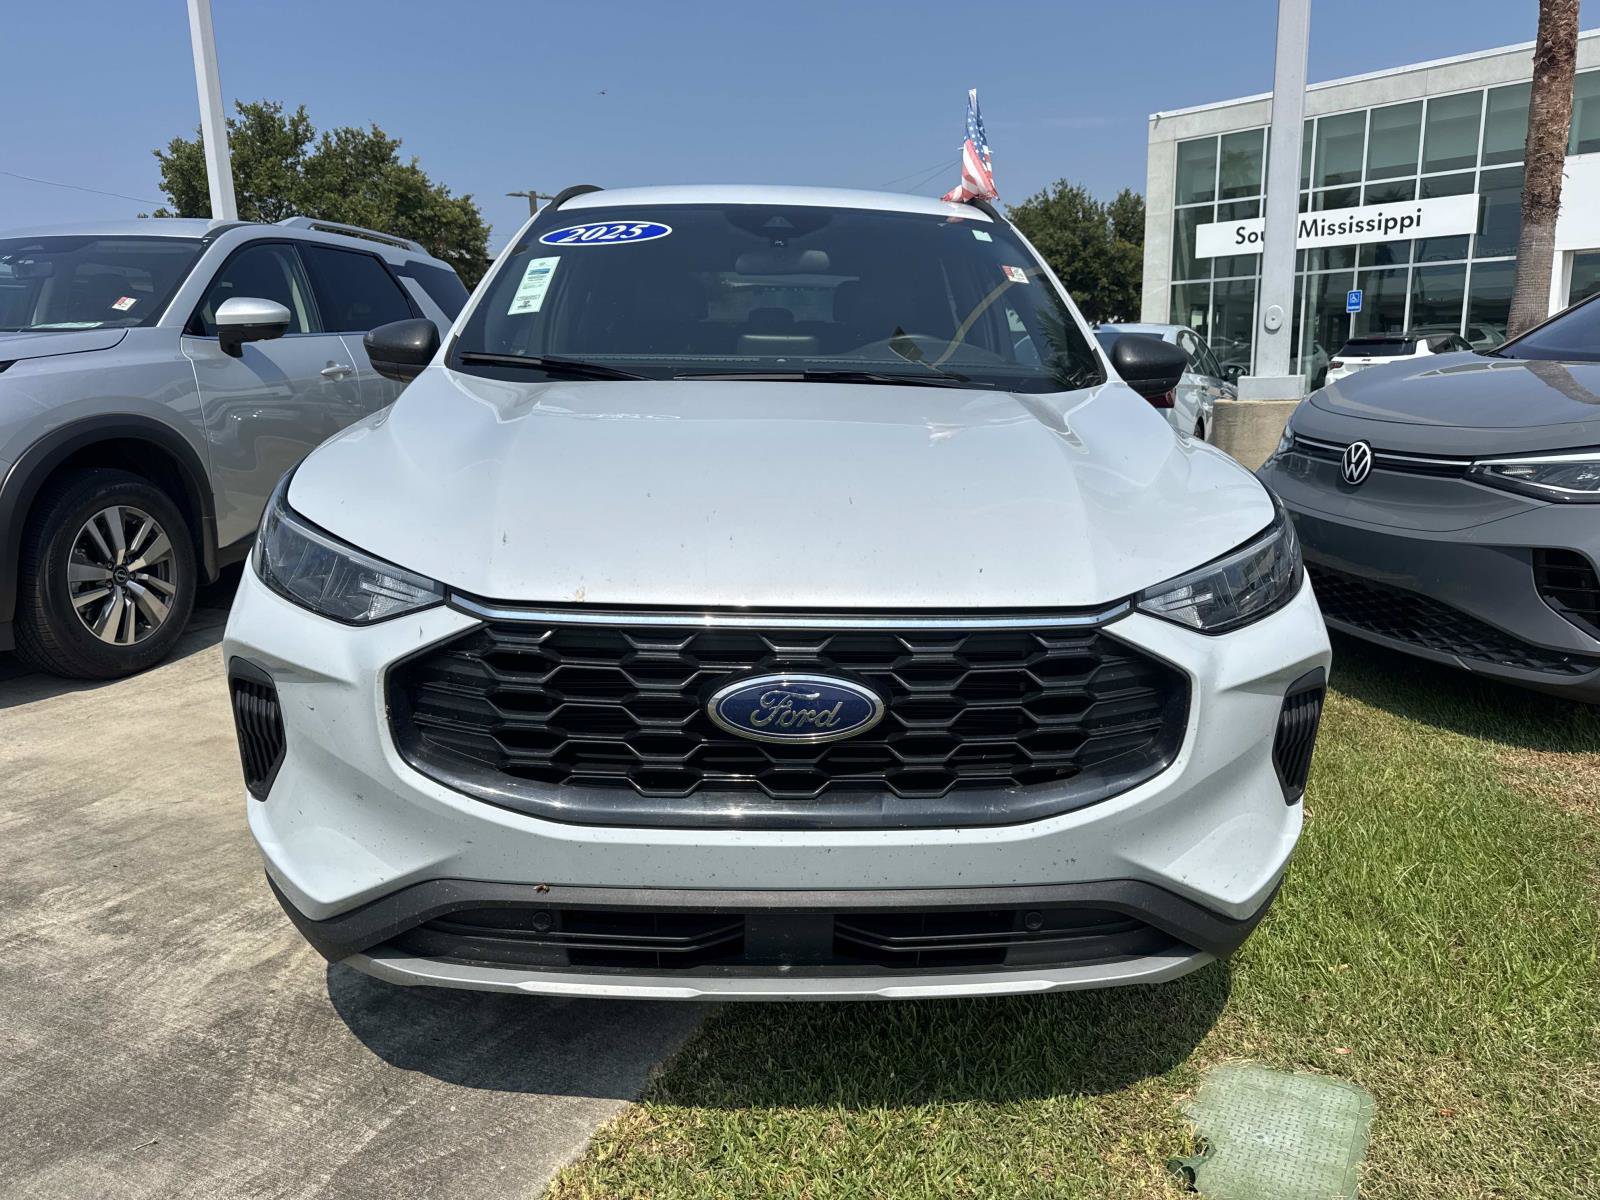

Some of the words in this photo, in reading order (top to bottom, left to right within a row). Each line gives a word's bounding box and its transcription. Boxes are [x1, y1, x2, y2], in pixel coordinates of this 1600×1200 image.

[556, 224, 651, 243] 2025
[1298, 208, 1422, 239] Mississippi
[750, 690, 844, 728] Ford
